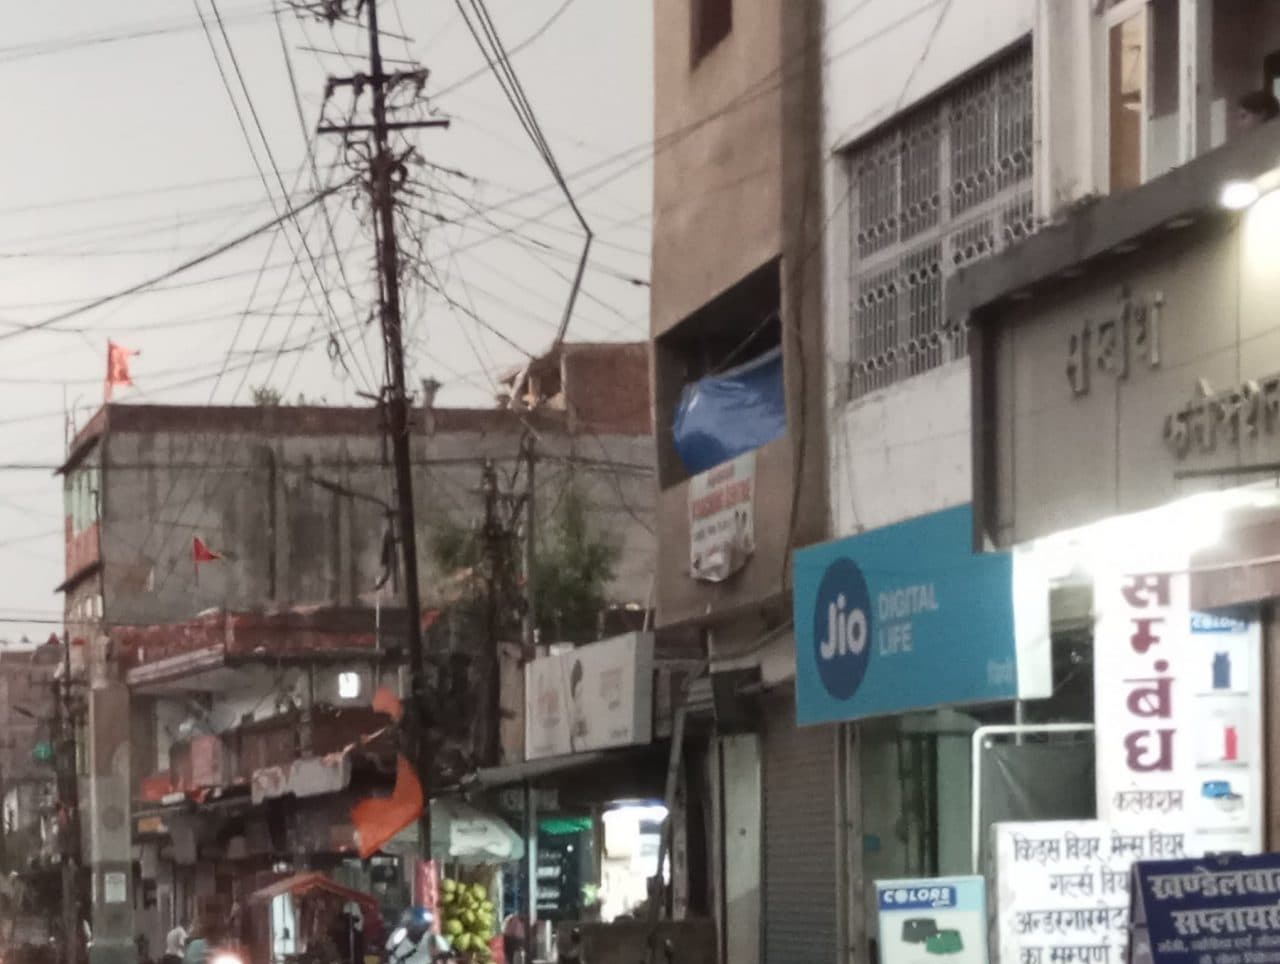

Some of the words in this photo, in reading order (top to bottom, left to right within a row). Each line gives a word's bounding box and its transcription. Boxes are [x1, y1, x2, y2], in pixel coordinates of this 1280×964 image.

[878, 583, 938, 621] DIGITAL
[821, 593, 868, 660] Jio
[879, 622, 913, 656] LIFE
[1147, 865, 1280, 899] खण्डेलवा
